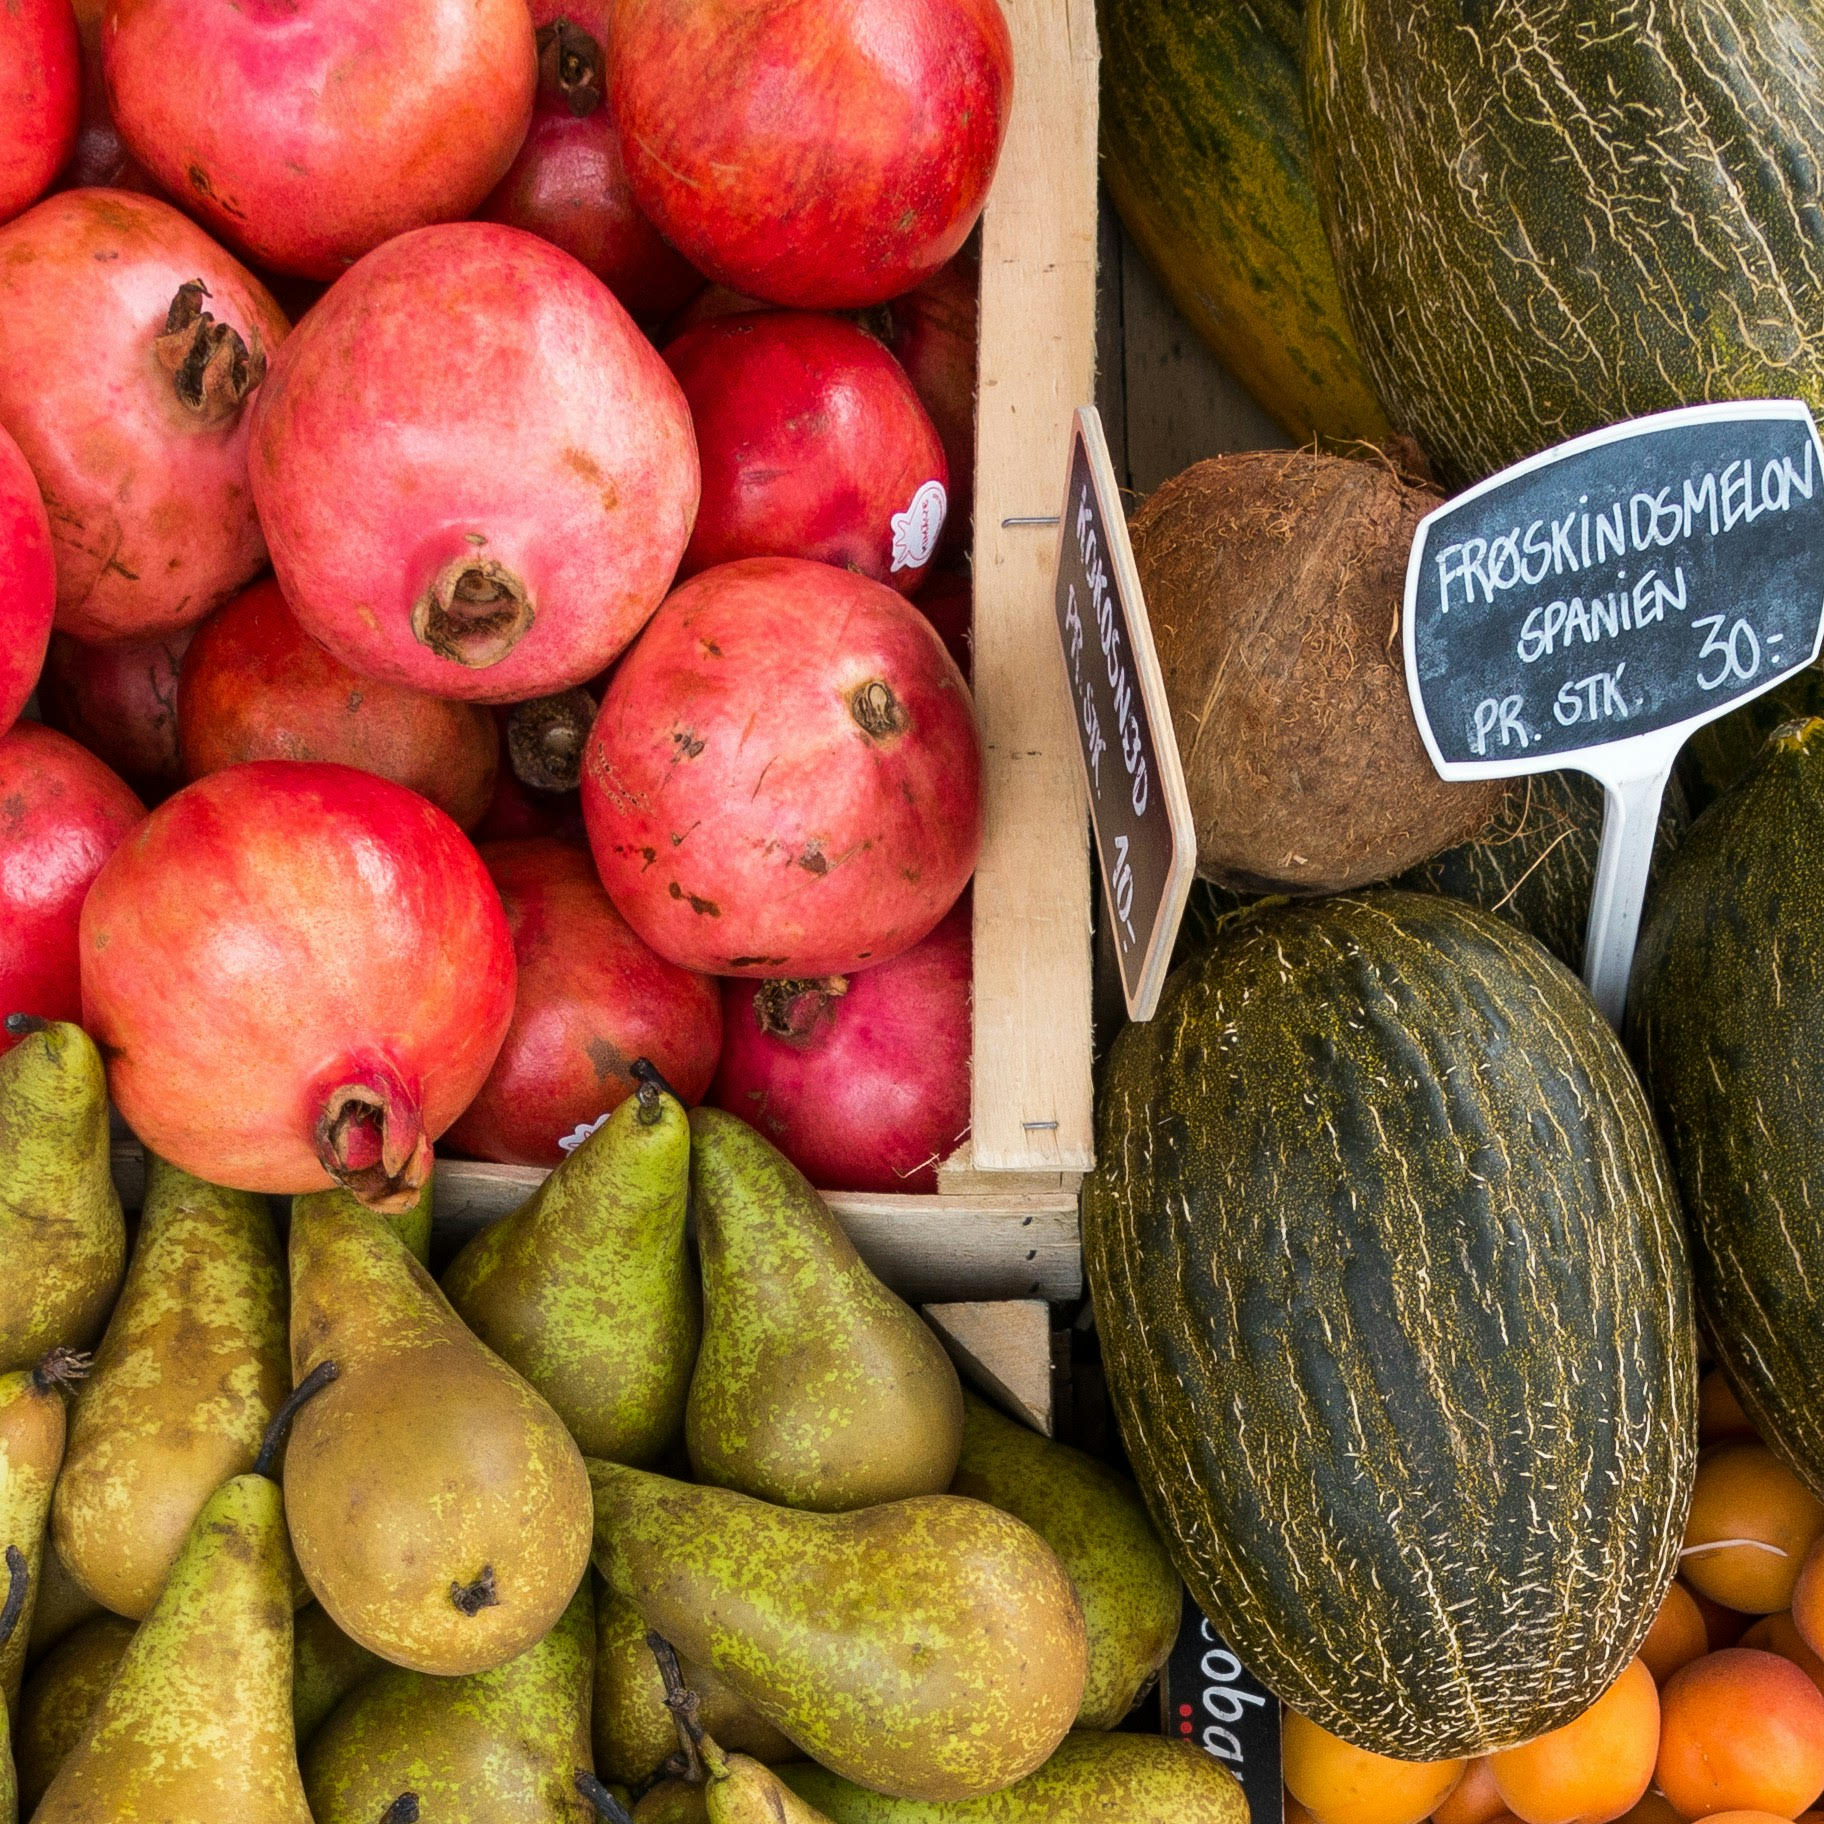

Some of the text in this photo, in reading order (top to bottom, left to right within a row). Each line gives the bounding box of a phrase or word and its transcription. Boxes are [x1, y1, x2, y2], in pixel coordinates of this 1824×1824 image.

[1435, 440, 1814, 613] FRØSKINDSMELON
[1518, 567, 1688, 663] SPANIEN
[1474, 695, 1543, 755] PR.
